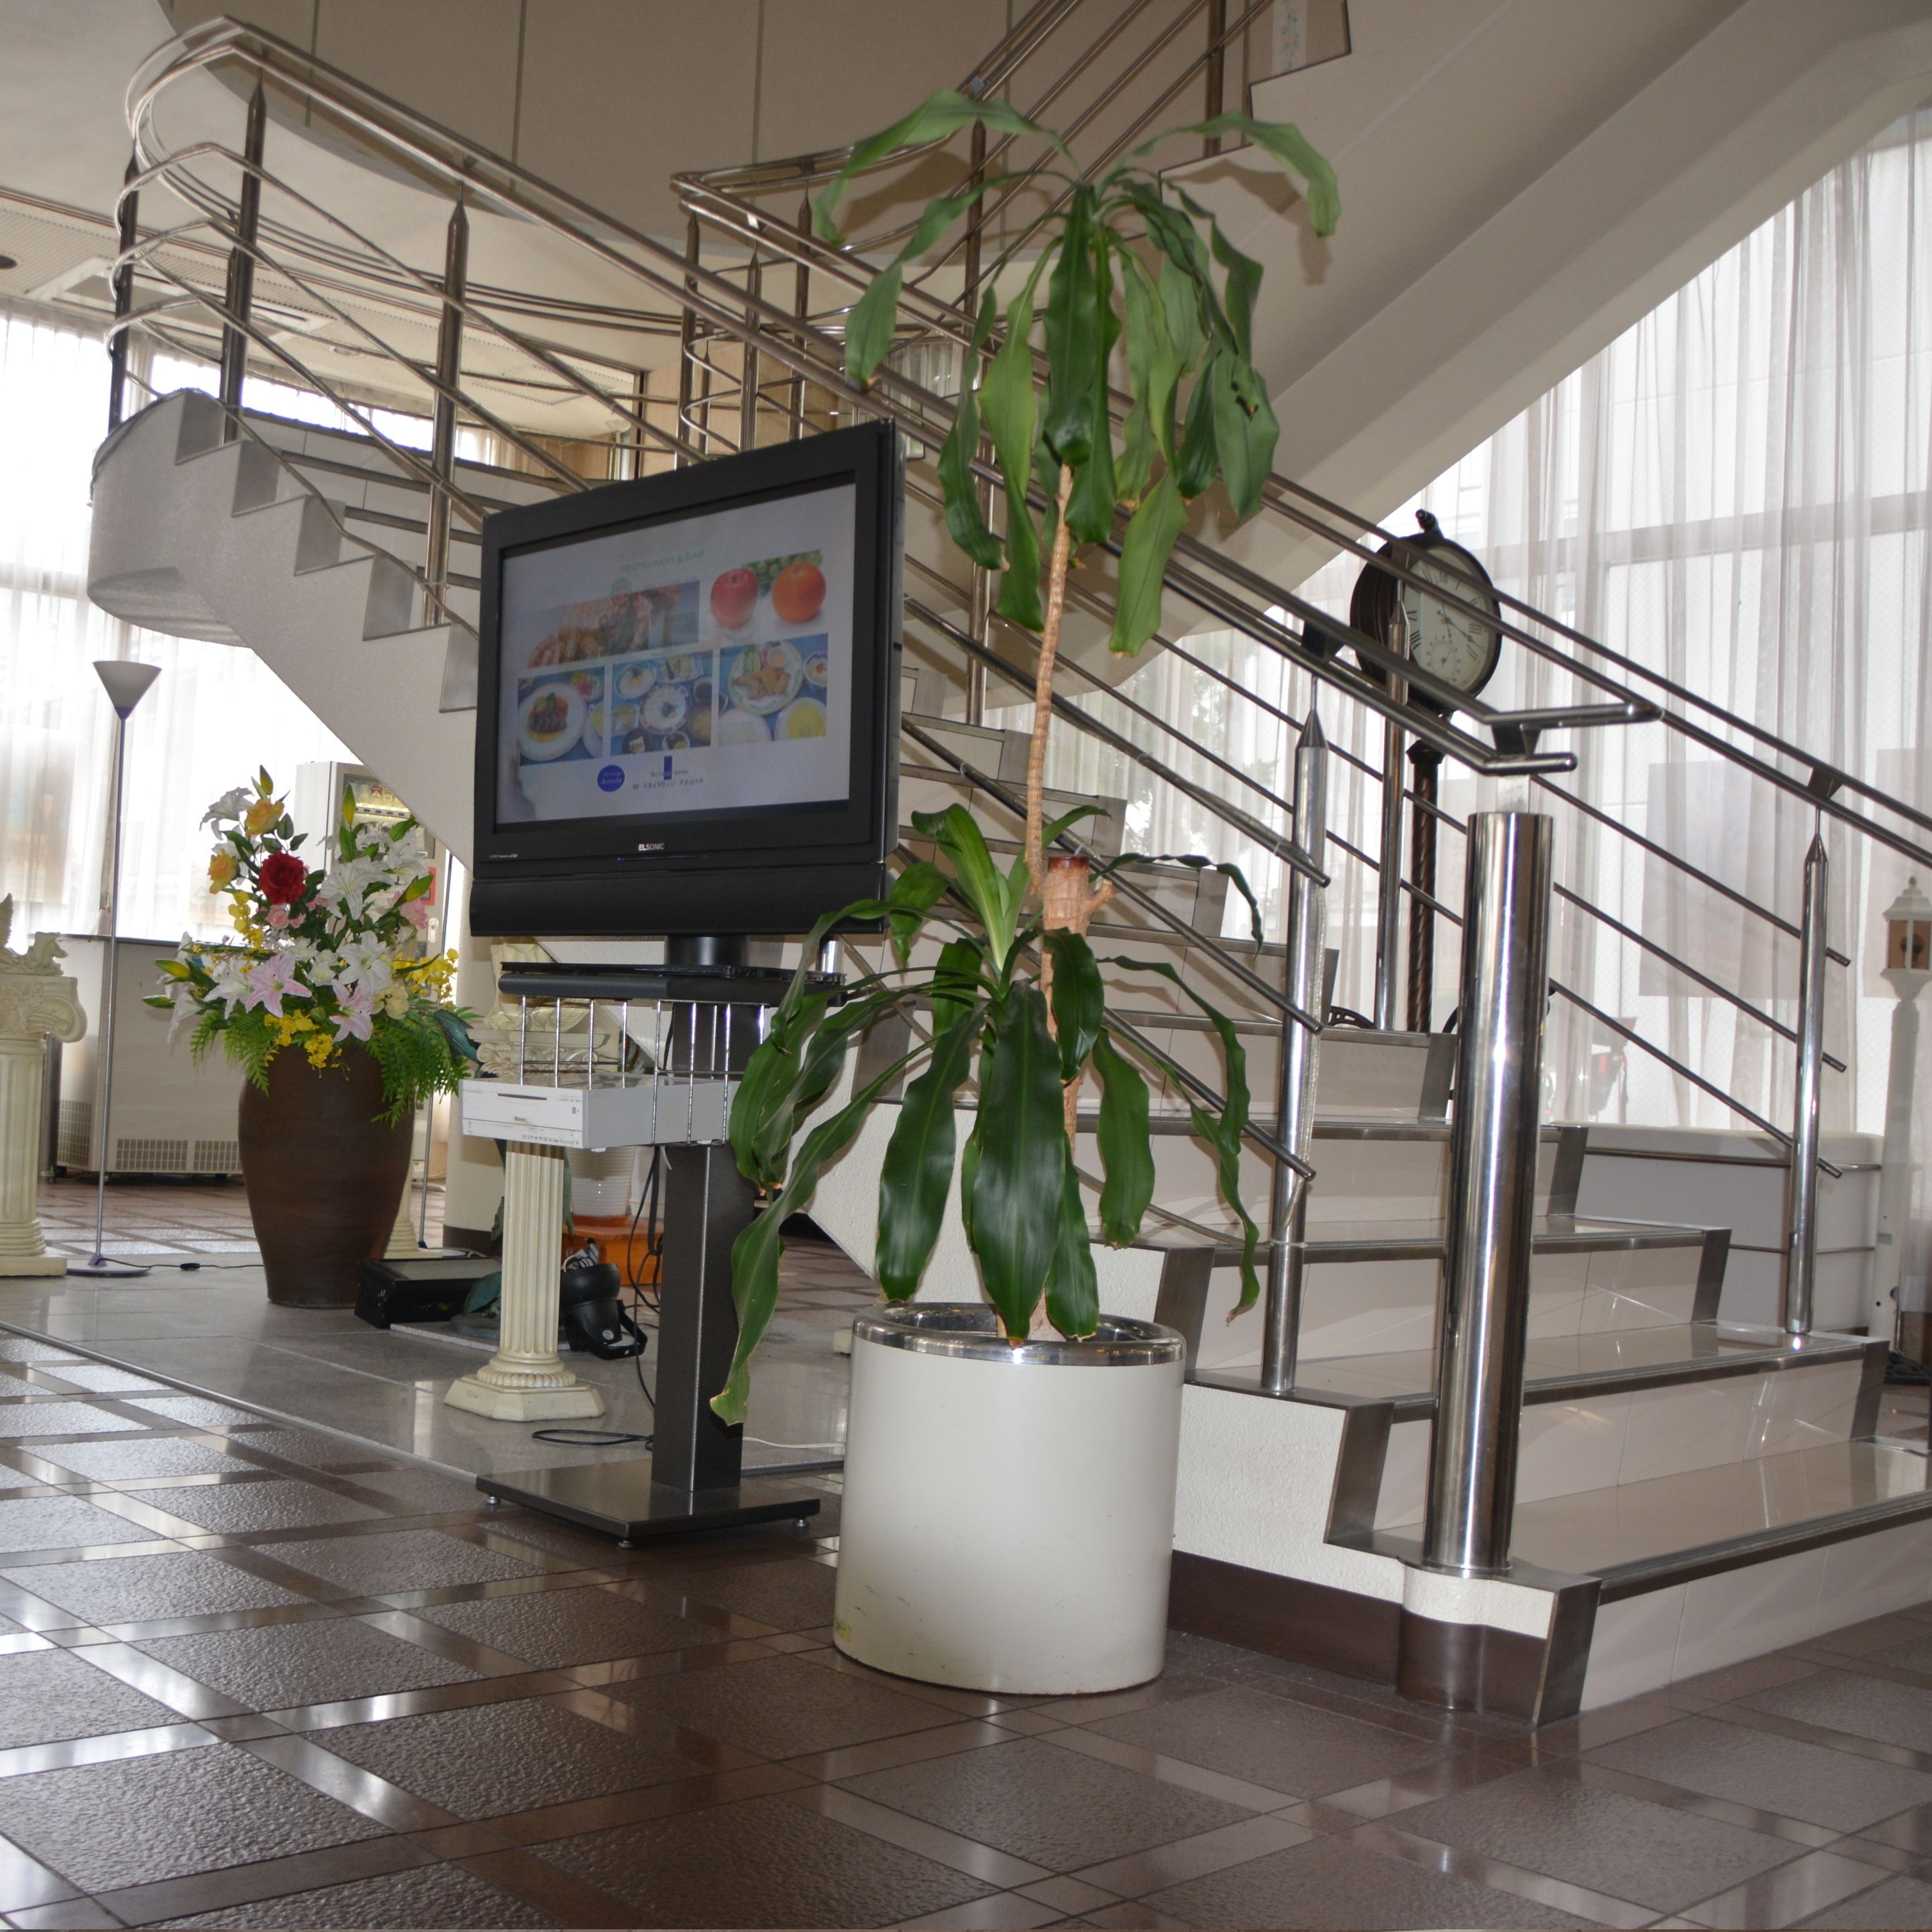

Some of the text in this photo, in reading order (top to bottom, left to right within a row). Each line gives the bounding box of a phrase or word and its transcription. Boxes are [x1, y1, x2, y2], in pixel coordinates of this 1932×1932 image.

[621, 550, 704, 572] RESTAURANT & BAR
[639, 843, 665, 851] ELSONIC
